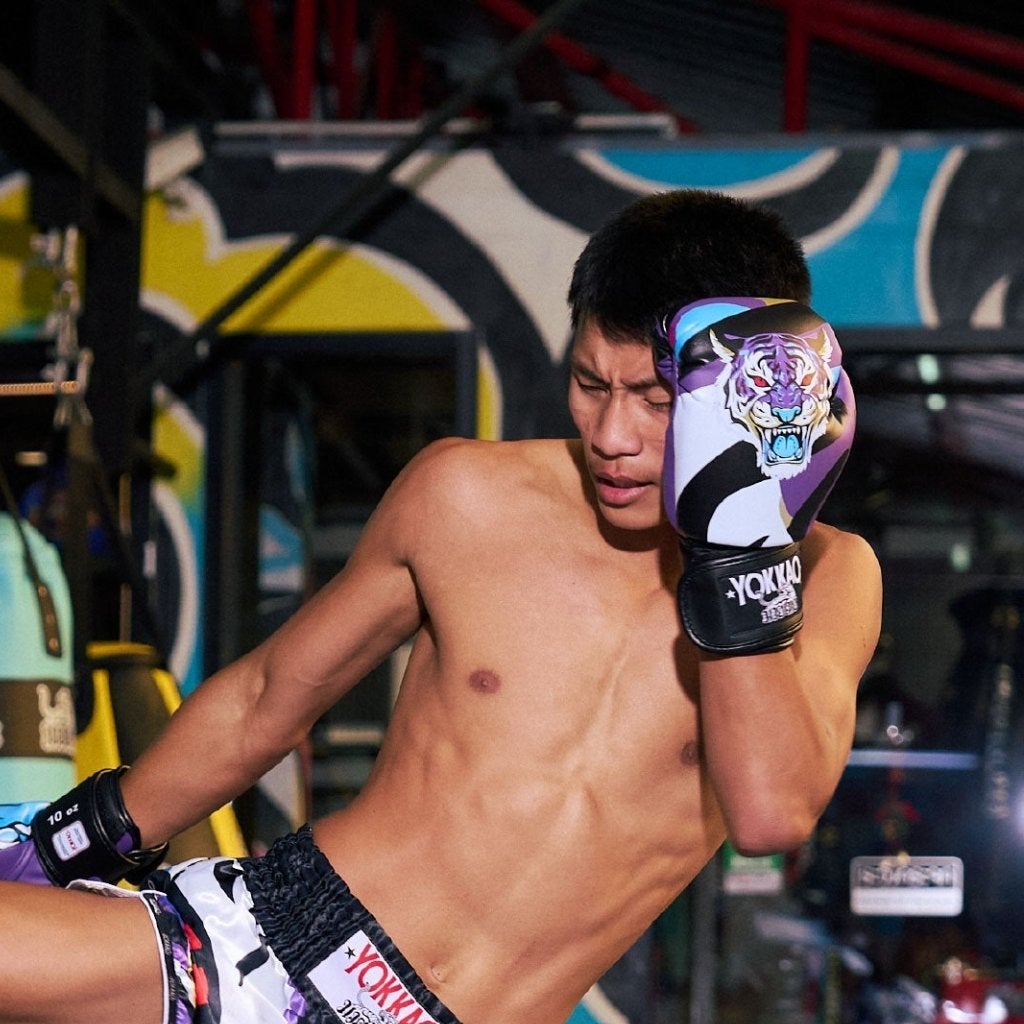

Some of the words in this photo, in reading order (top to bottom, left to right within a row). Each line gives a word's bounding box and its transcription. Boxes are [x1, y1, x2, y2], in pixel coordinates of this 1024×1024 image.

[729, 555, 802, 607] YOKKAO
[47, 811, 63, 826] 10
[66, 804, 79, 816] oz
